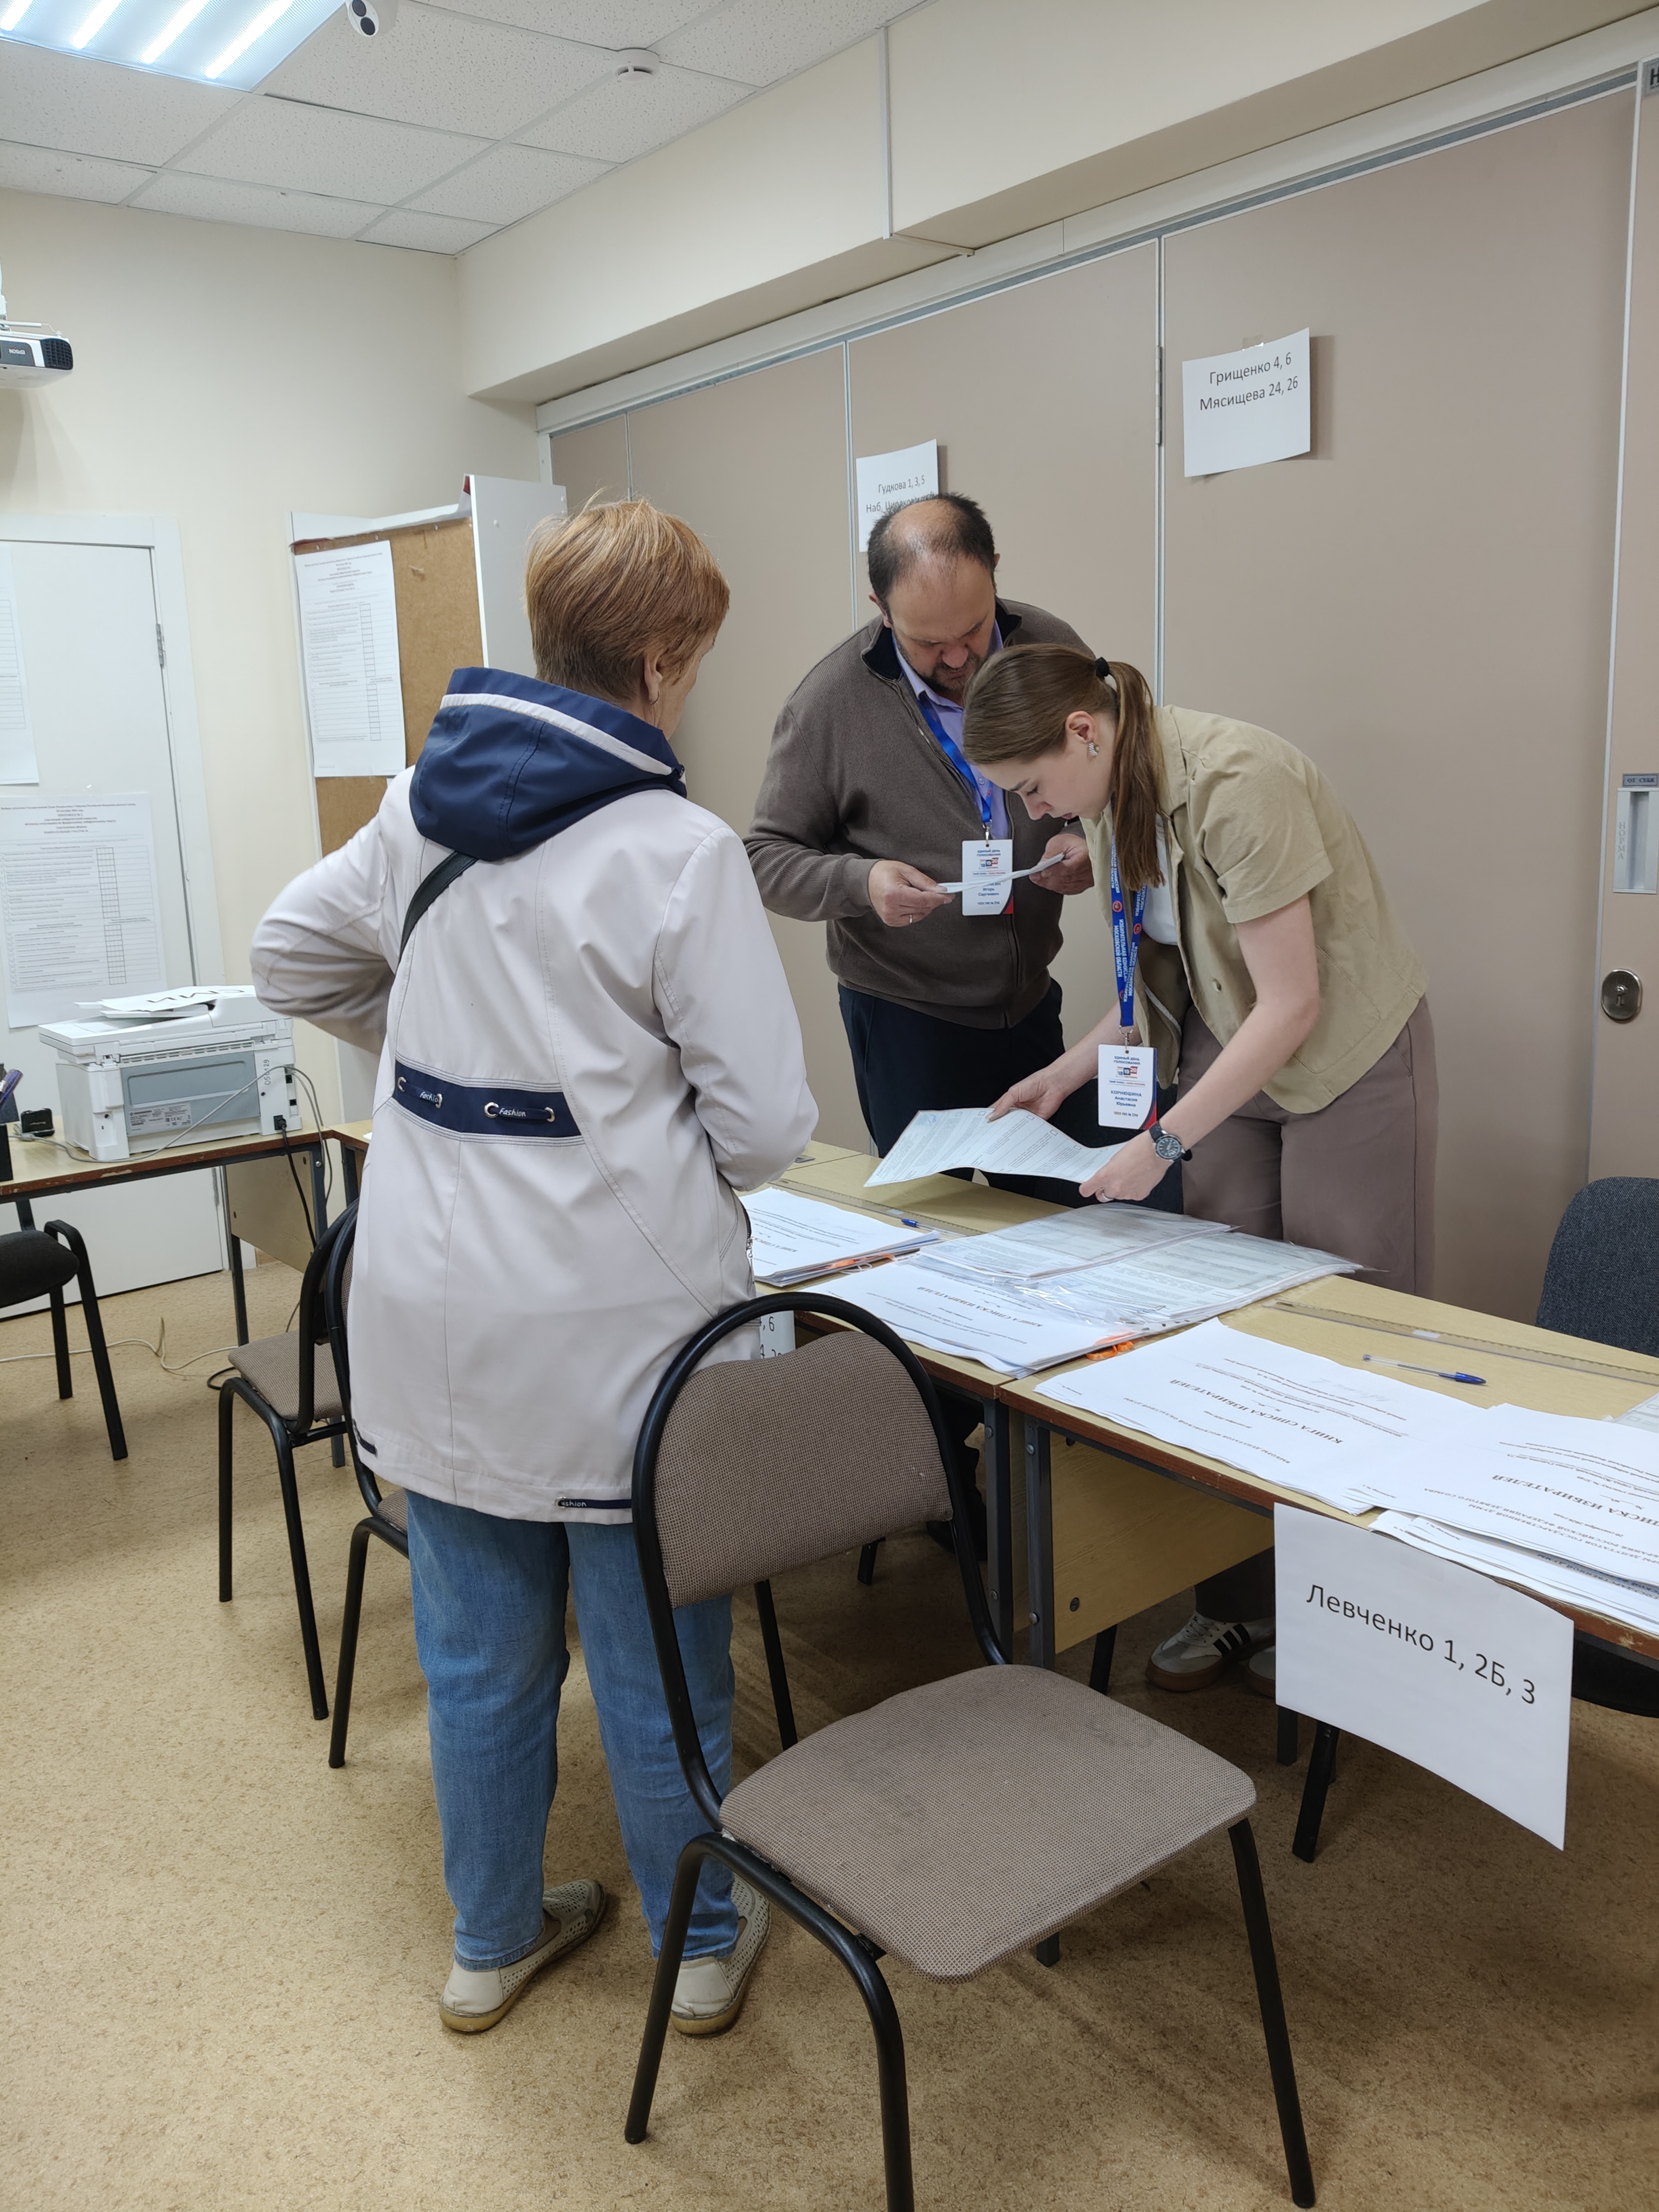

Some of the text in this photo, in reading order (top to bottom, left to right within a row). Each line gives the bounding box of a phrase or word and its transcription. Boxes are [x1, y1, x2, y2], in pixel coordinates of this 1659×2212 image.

[1210, 352, 1292, 386] Грищенко 4, 6
[1199, 375, 1299, 411] Мясищева 24, 26
[878, 475, 926, 495] Гудкова 1, 3, 5
[866, 502, 884, 513] Наб.
[1119, 919, 1127, 956] ИЗБИРАТЕЛЬНАЯ
[499, 1108, 527, 1117] Fashion
[916, 1286, 976, 1307] ИЗБИРАТЕЛЕЙ
[976, 1305, 1011, 1319] СПИСКА
[769, 1316, 775, 1332] 6
[1170, 1379, 1343, 1444] КНИГА СПИСКА ИЗБИРАТЕЛЕЙ
[1424, 1488, 1456, 1498] СОЗЫВА
[1458, 1496, 1503, 1509] ДЕВЯТОГО
[1492, 1475, 1603, 1510] ИЗБИРАТЕЛЕЙ
[1468, 1504, 1496, 1513] ДУМЫ
[1502, 1508, 1555, 1527] ФЕДЕРАЦИИ
[1496, 1512, 1583, 1542] ГОСУДАРСТВЕННОЙ
[1556, 1526, 1620, 1547] РОССИЙСКОЙ
[1584, 1540, 1641, 1559] ДЕПУТАТОВ
[1306, 1584, 1536, 1705] Левченко 1, 2Б, 3
